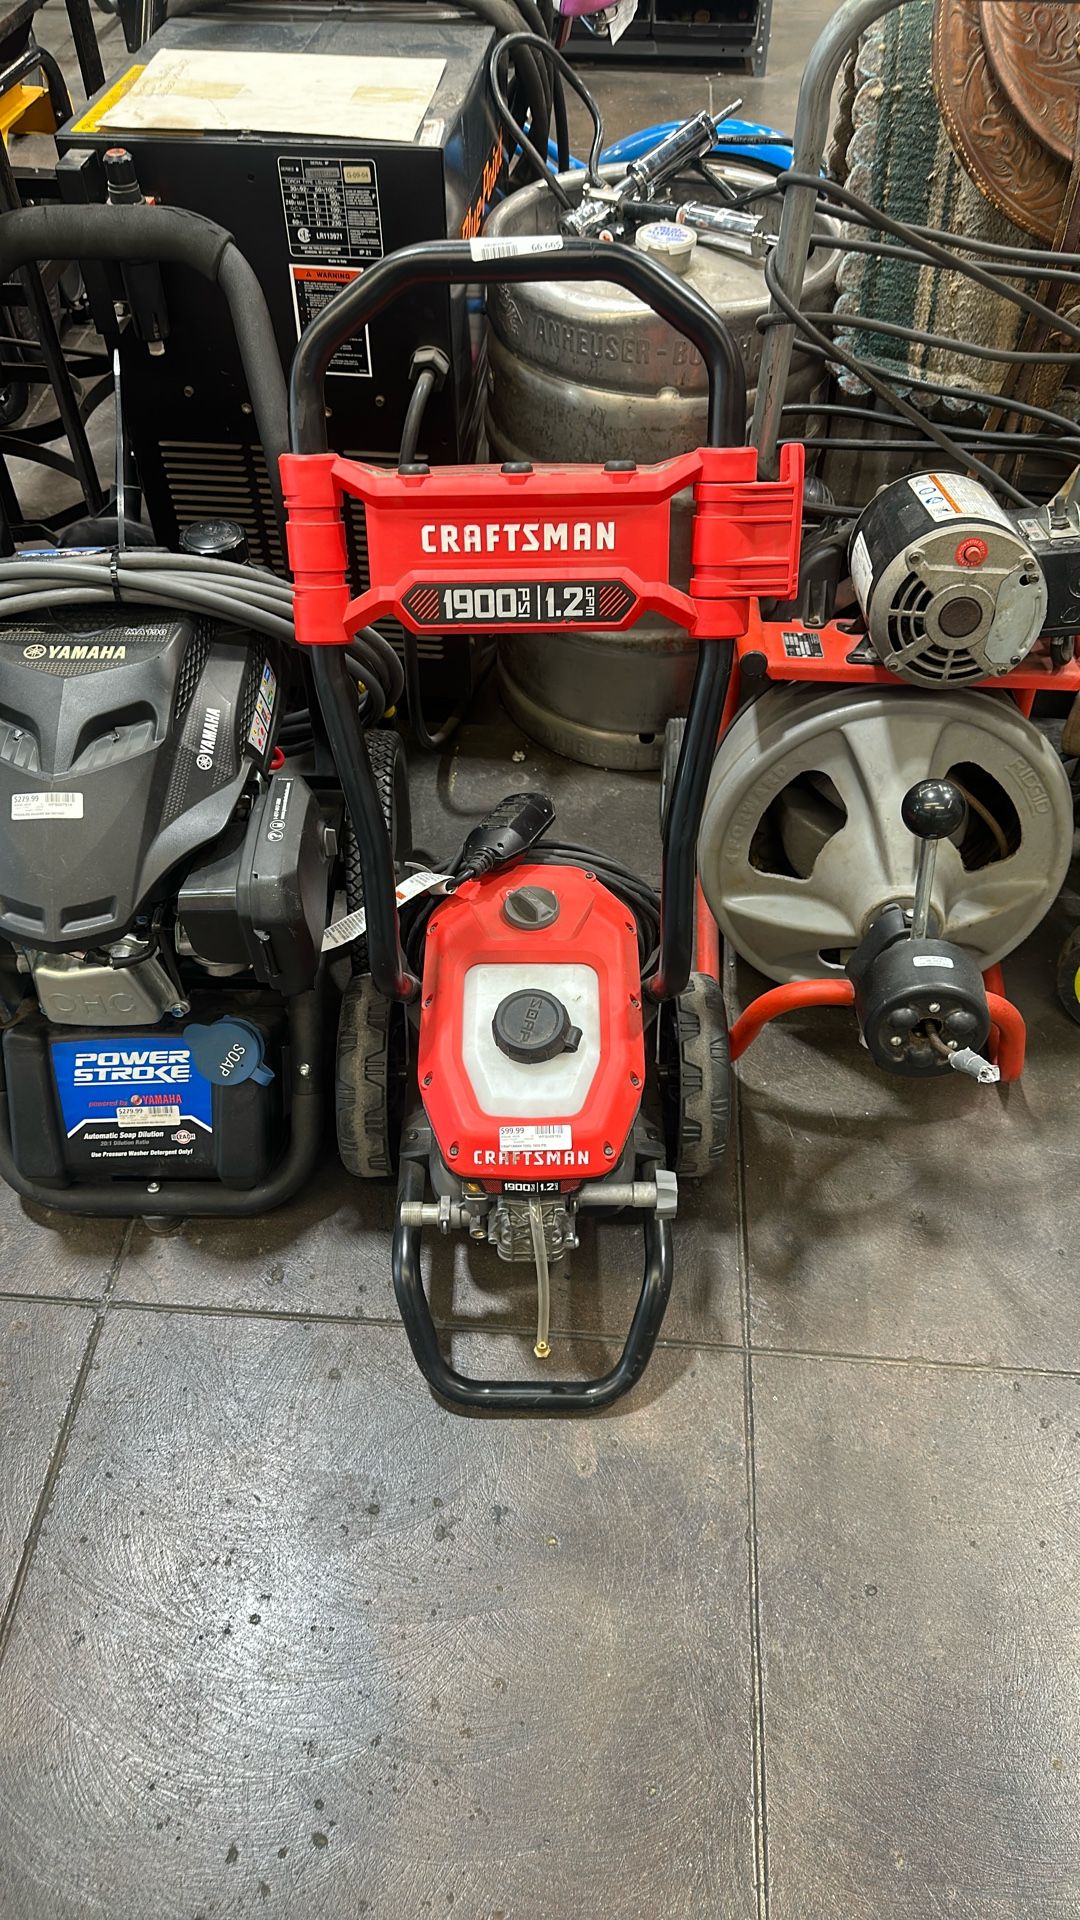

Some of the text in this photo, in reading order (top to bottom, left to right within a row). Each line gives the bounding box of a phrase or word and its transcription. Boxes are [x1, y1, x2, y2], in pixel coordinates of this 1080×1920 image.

[316, 271, 351, 280] WARNING
[421, 521, 615, 553] CRAFTSMAN
[443, 586, 595, 620] 1900 PSI 1.2 GPM
[48, 645, 126, 660] YAMAHA
[198, 707, 221, 755] YAMAHA
[1006, 756, 1050, 815] RIDGID
[13, 795, 39, 804] $279.99
[49, 992, 136, 1014] OHC
[519, 998, 543, 1043] SOAP
[75, 1050, 190, 1067] POWER
[219, 1043, 246, 1077] SOAP
[73, 1064, 190, 1084] STROKE
[88, 1100, 118, 1108] powered
[142, 1094, 183, 1104] YAMAHA
[83, 1132, 118, 1140] Automatic
[119, 1131, 137, 1139] Soap
[500, 1127, 525, 1135] $99.99
[150, 1149, 178, 1157] Detergent
[178, 1148, 193, 1156] Only!
[473, 1150, 589, 1165] CRAFTSMAN
[503, 1182, 531, 1192] 1900
[540, 1182, 555, 1192] 1.2
